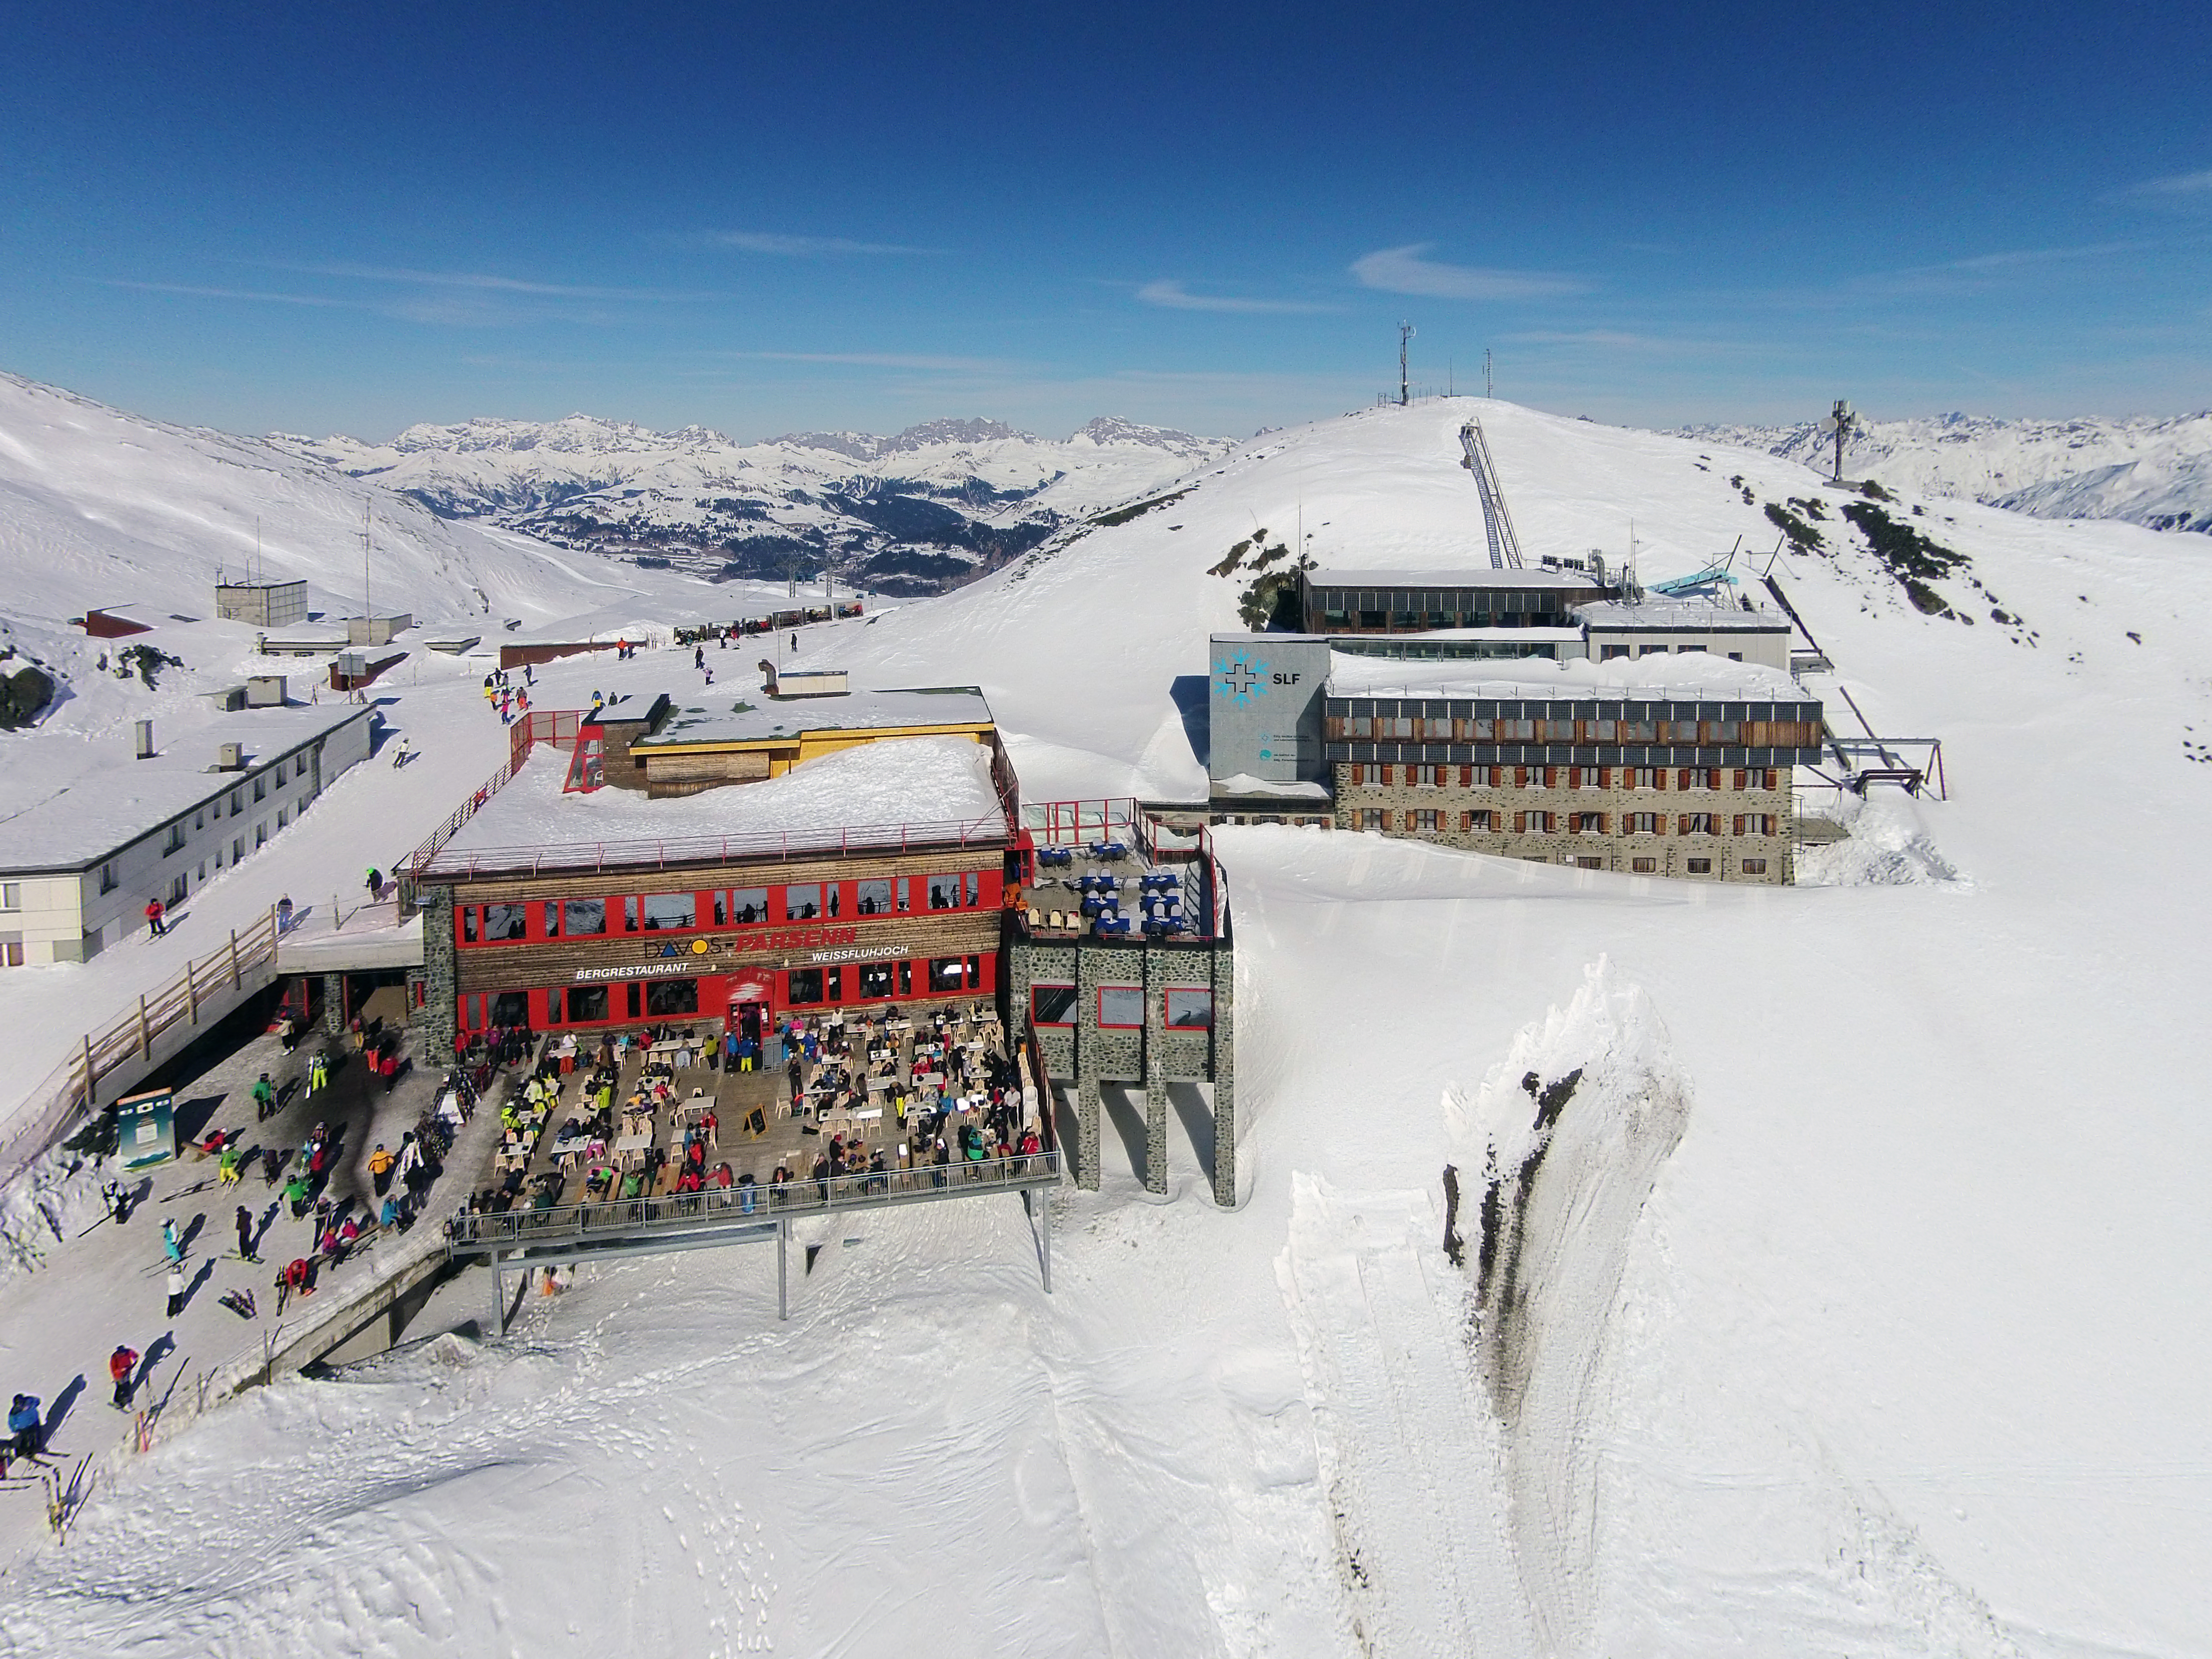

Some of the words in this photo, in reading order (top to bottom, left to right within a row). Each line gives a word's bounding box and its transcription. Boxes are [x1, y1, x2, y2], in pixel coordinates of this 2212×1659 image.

[1273, 673, 1300, 685] SLF
[644, 937, 722, 958] DAVOS
[735, 926, 857, 953] PARSENN
[576, 963, 689, 979] BERGRESTAURANT
[812, 946, 909, 961] WEISSFLUHJOCH
